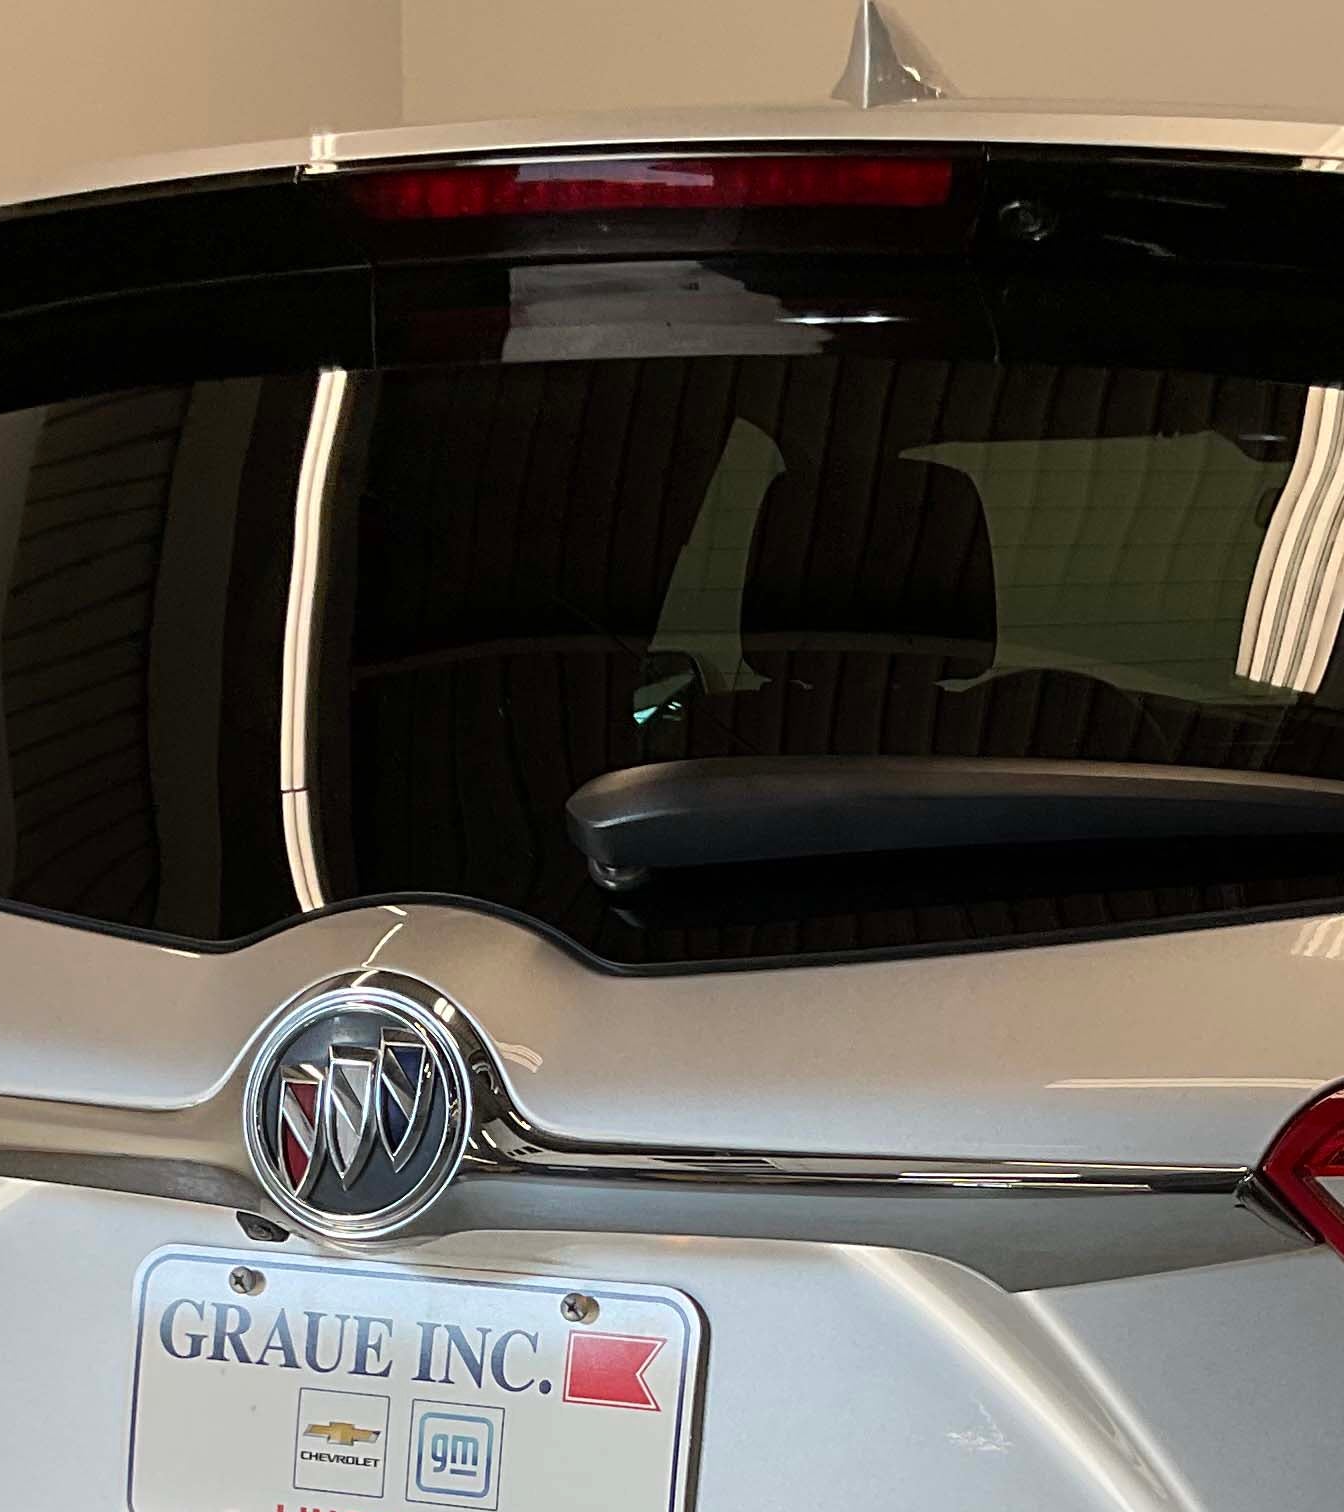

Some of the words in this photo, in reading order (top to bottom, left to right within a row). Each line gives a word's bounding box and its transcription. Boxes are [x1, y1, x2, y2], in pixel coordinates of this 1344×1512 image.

[159, 1299, 394, 1377] GRAUE
[411, 1321, 552, 1395] INC.
[300, 1450, 381, 1468] CHEVROLET
[431, 1433, 480, 1477] gm
